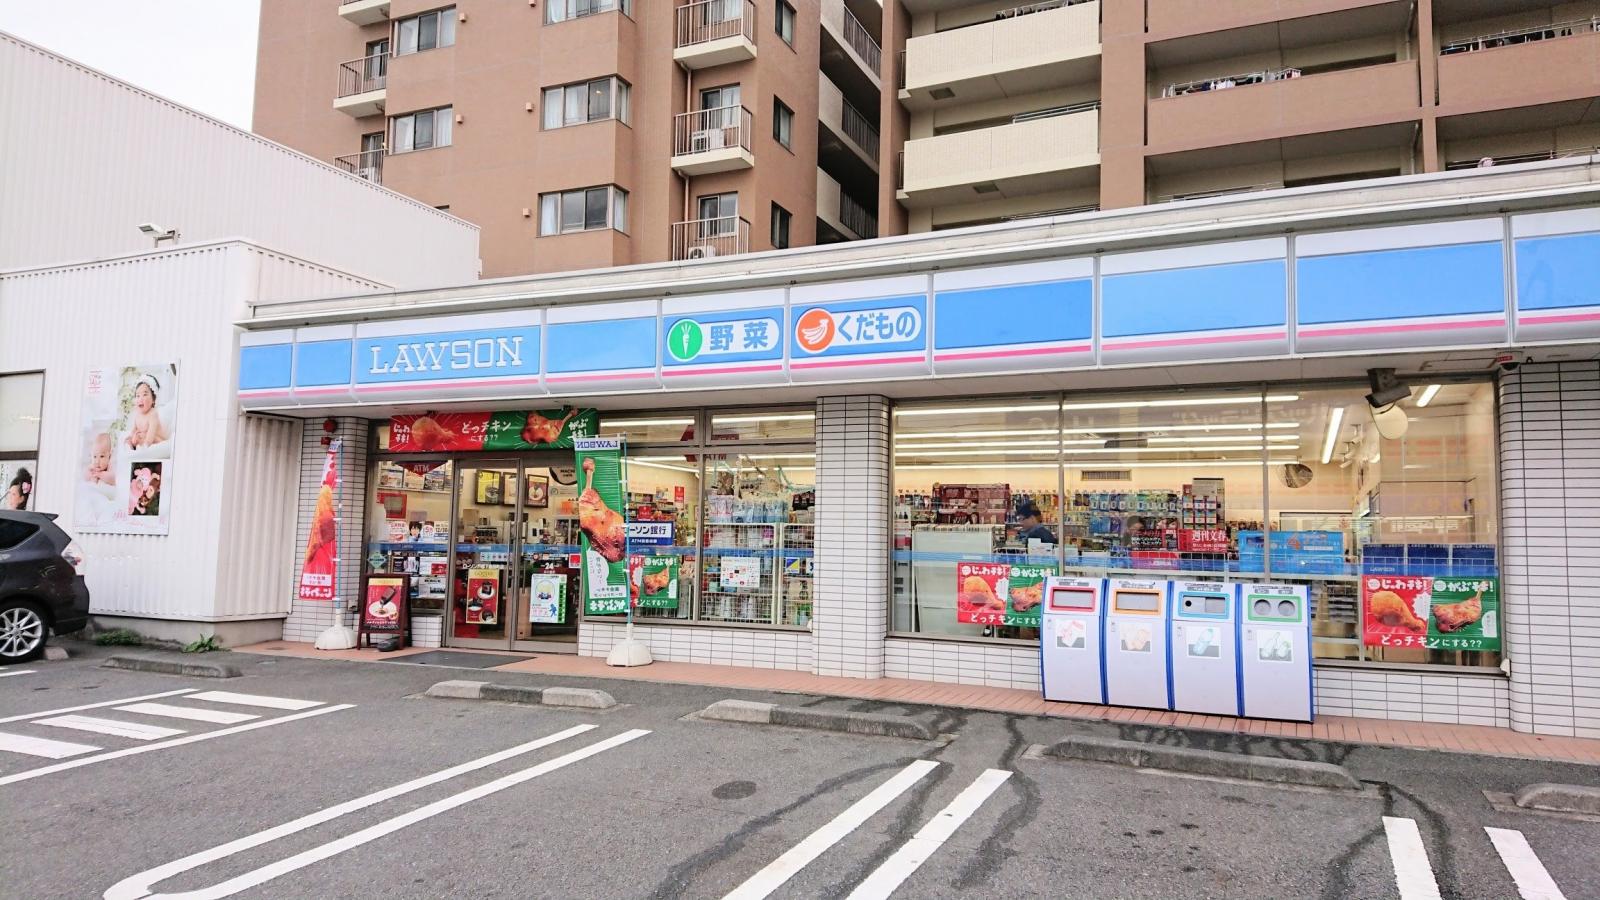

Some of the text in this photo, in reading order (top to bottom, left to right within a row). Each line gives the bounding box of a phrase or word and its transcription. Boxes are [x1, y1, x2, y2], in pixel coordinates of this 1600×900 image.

[710, 321, 769, 351] 野菜
[838, 311, 916, 341] くだもの
[370, 336, 523, 374] LAWSON
[461, 420, 512, 434] どっチキン
[624, 525, 667, 535] ーソン銀行
